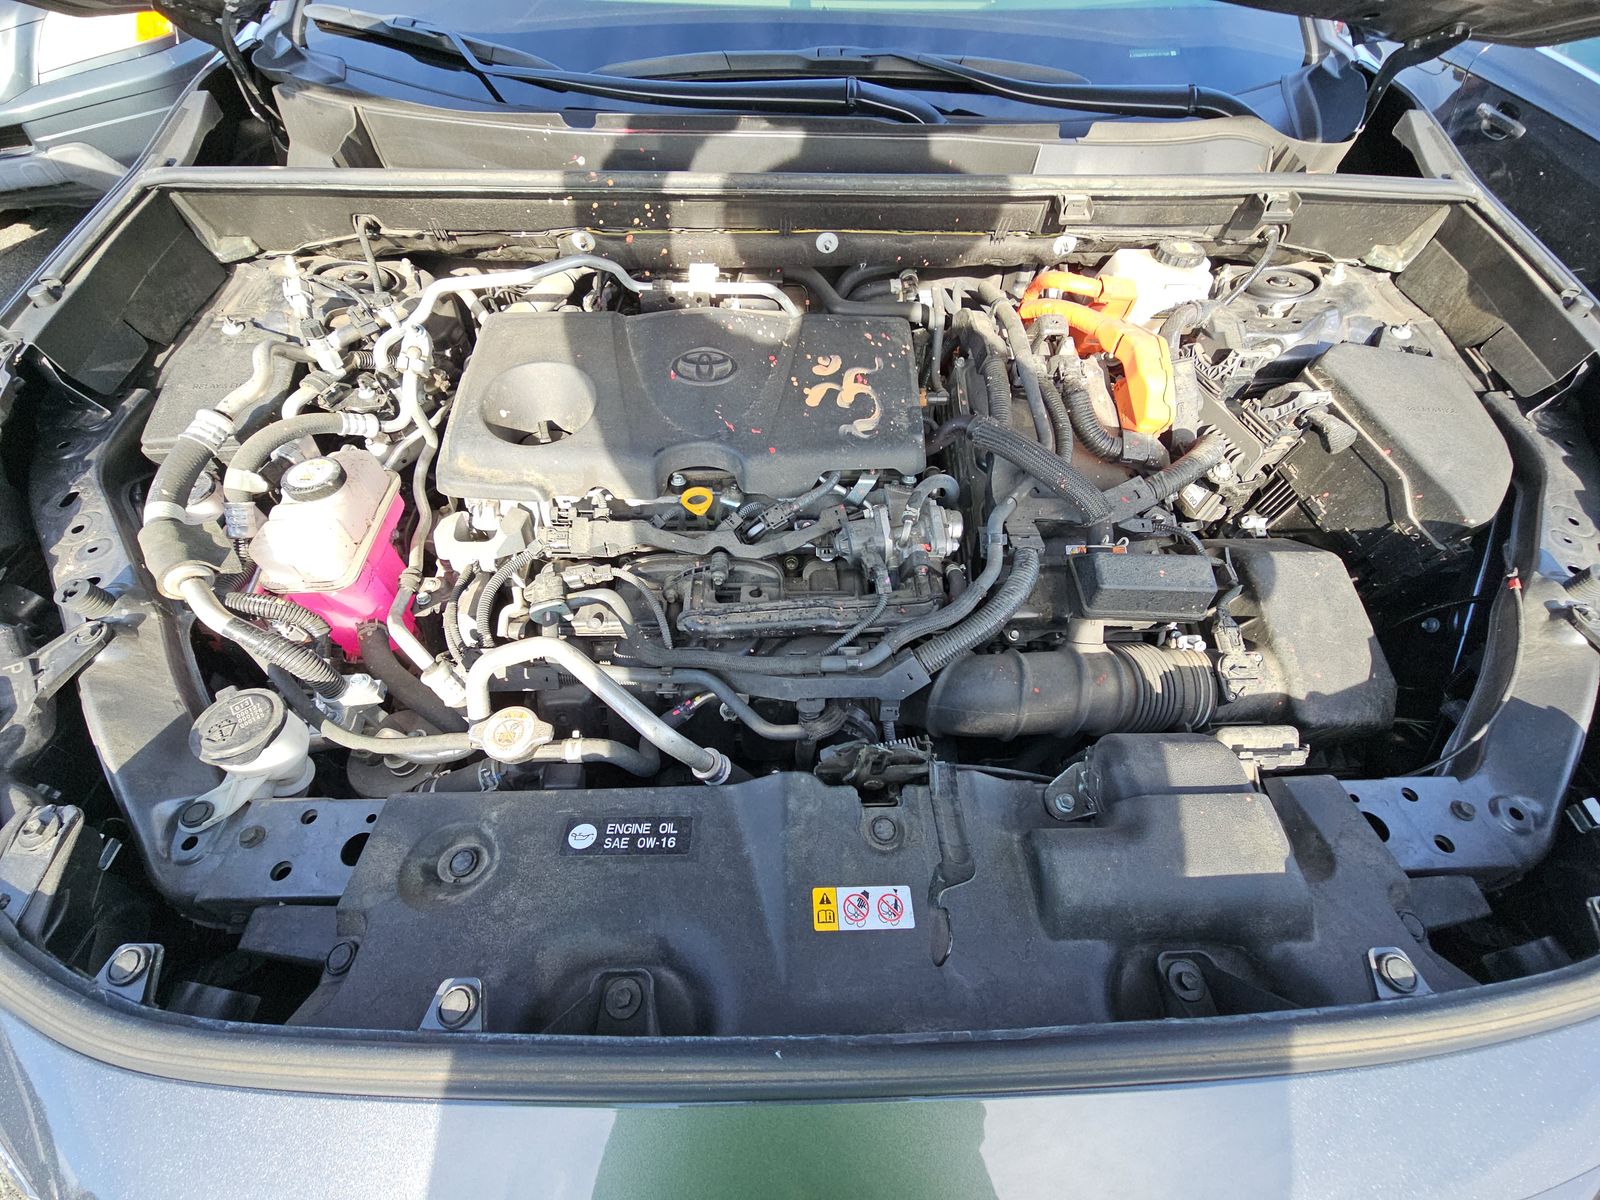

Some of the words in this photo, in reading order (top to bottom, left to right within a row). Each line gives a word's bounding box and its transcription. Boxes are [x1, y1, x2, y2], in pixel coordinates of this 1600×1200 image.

[606, 823, 651, 834] ENGINE
[659, 822, 678, 834] OIL
[603, 837, 630, 849] SAE
[637, 837, 676, 849] 0W-16
